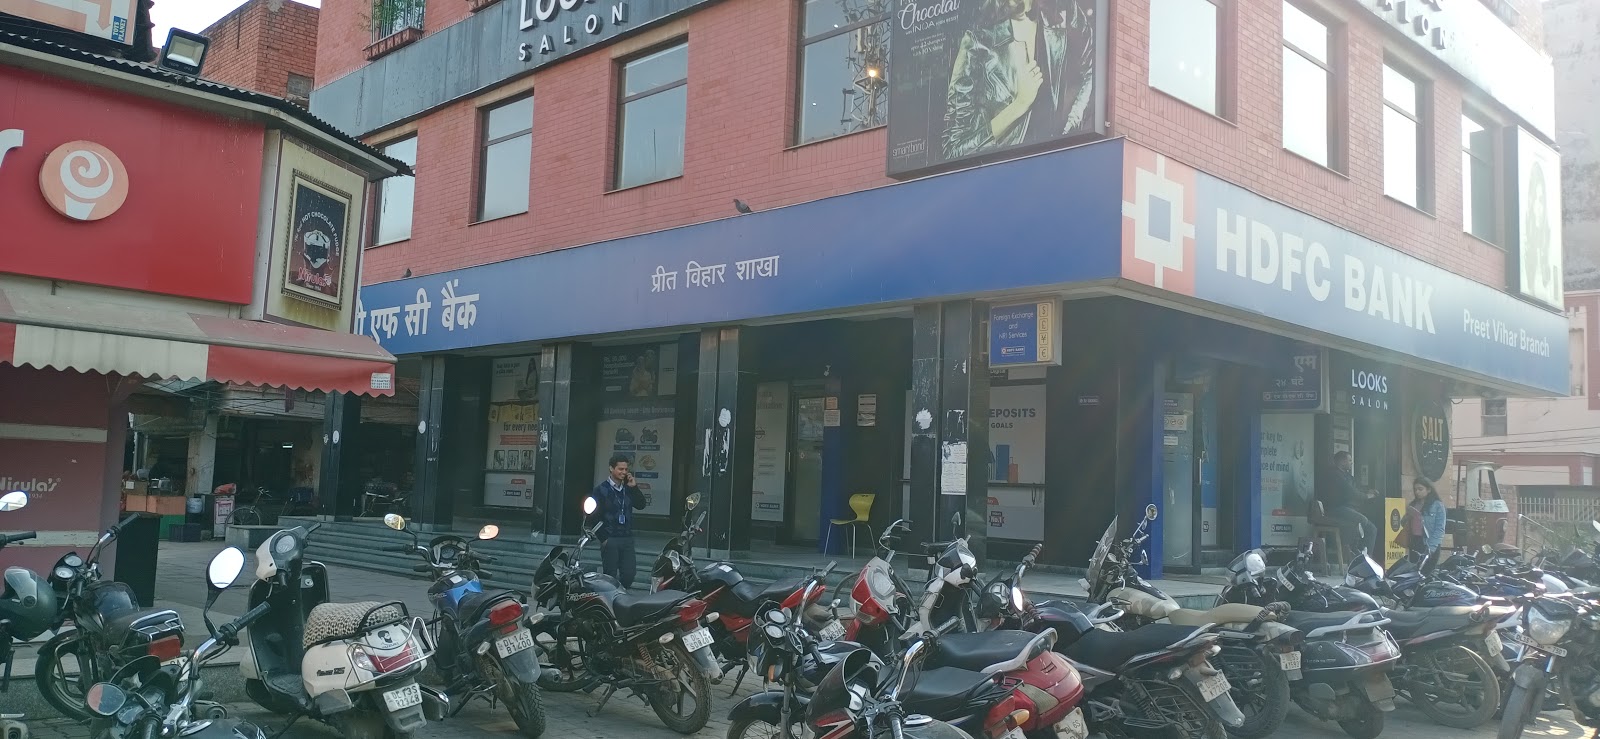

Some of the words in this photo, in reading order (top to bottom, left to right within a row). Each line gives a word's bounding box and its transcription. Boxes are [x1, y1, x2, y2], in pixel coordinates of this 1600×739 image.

[518, 2, 624, 61] SALON
[301, 212, 312, 224] HOT
[311, 211, 336, 235] CHOCOLATE
[651, 265, 678, 293] प्रीत
[685, 260, 727, 289] विहार
[735, 255, 780, 281] शाखा
[1216, 207, 1331, 302] HDFC
[1344, 253, 1436, 335] BANK
[440, 278, 480, 332] बैंक
[1011, 312, 1034, 320] Exchange
[1463, 308, 1491, 340] Preet
[1492, 319, 1518, 348] Vihar
[1519, 328, 1550, 358] Branch
[1351, 368, 1388, 394] LOOKS
[1351, 394, 1389, 411] SALON
[511, 424, 526, 433] every
[1421, 415, 1444, 442] SALT
